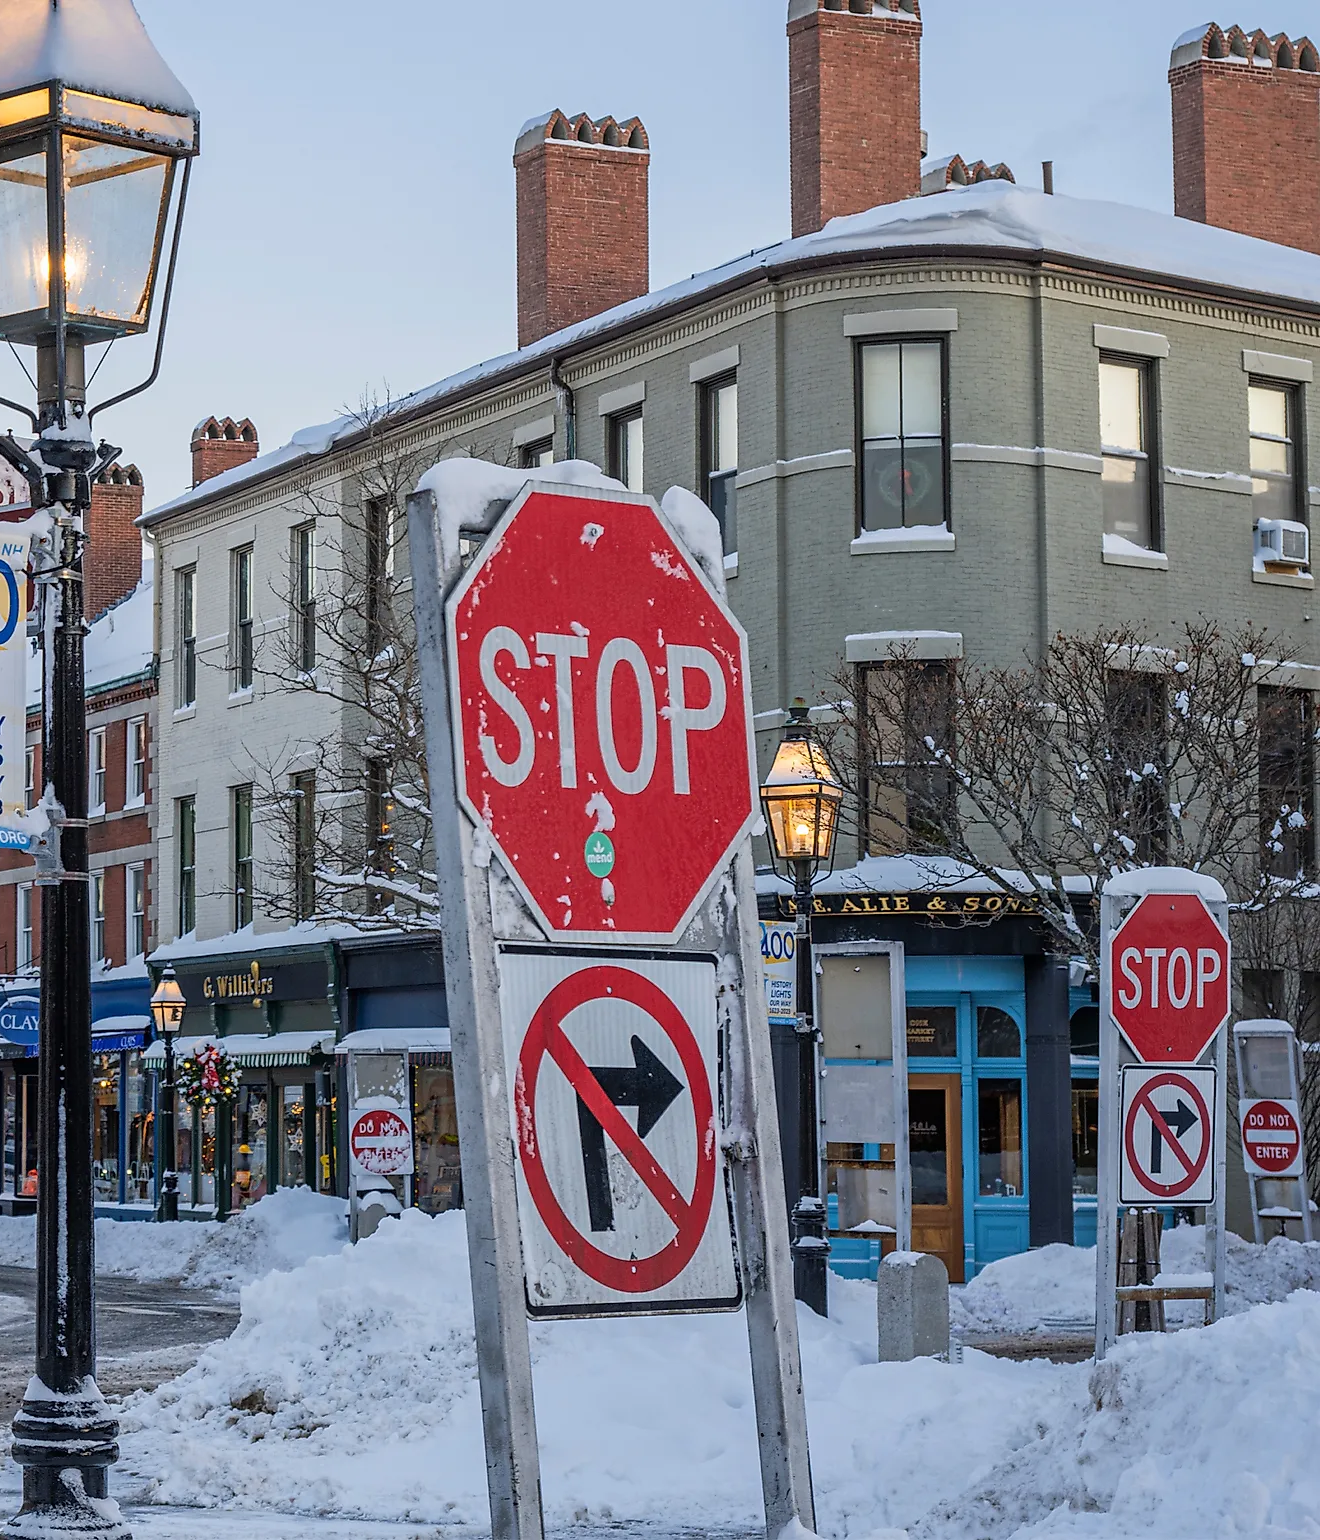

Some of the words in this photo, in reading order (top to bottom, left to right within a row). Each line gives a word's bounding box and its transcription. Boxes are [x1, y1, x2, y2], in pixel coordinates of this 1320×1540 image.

[478, 626, 728, 796] STOP
[587, 851, 613, 863] mend
[841, 896, 910, 914] ALIE
[927, 896, 947, 912] &
[761, 930, 795, 959] 400
[771, 981, 793, 989] HISTORY
[1118, 946, 1222, 1010] STOP
[203, 976, 215, 999] G.
[770, 990, 792, 999] LIGHTS
[0, 1014, 40, 1031] CLAY
[359, 1122, 374, 1134] DO
[1249, 1114, 1264, 1126] DO
[1269, 1114, 1290, 1127] NOT
[1256, 1146, 1289, 1159] ENTER
